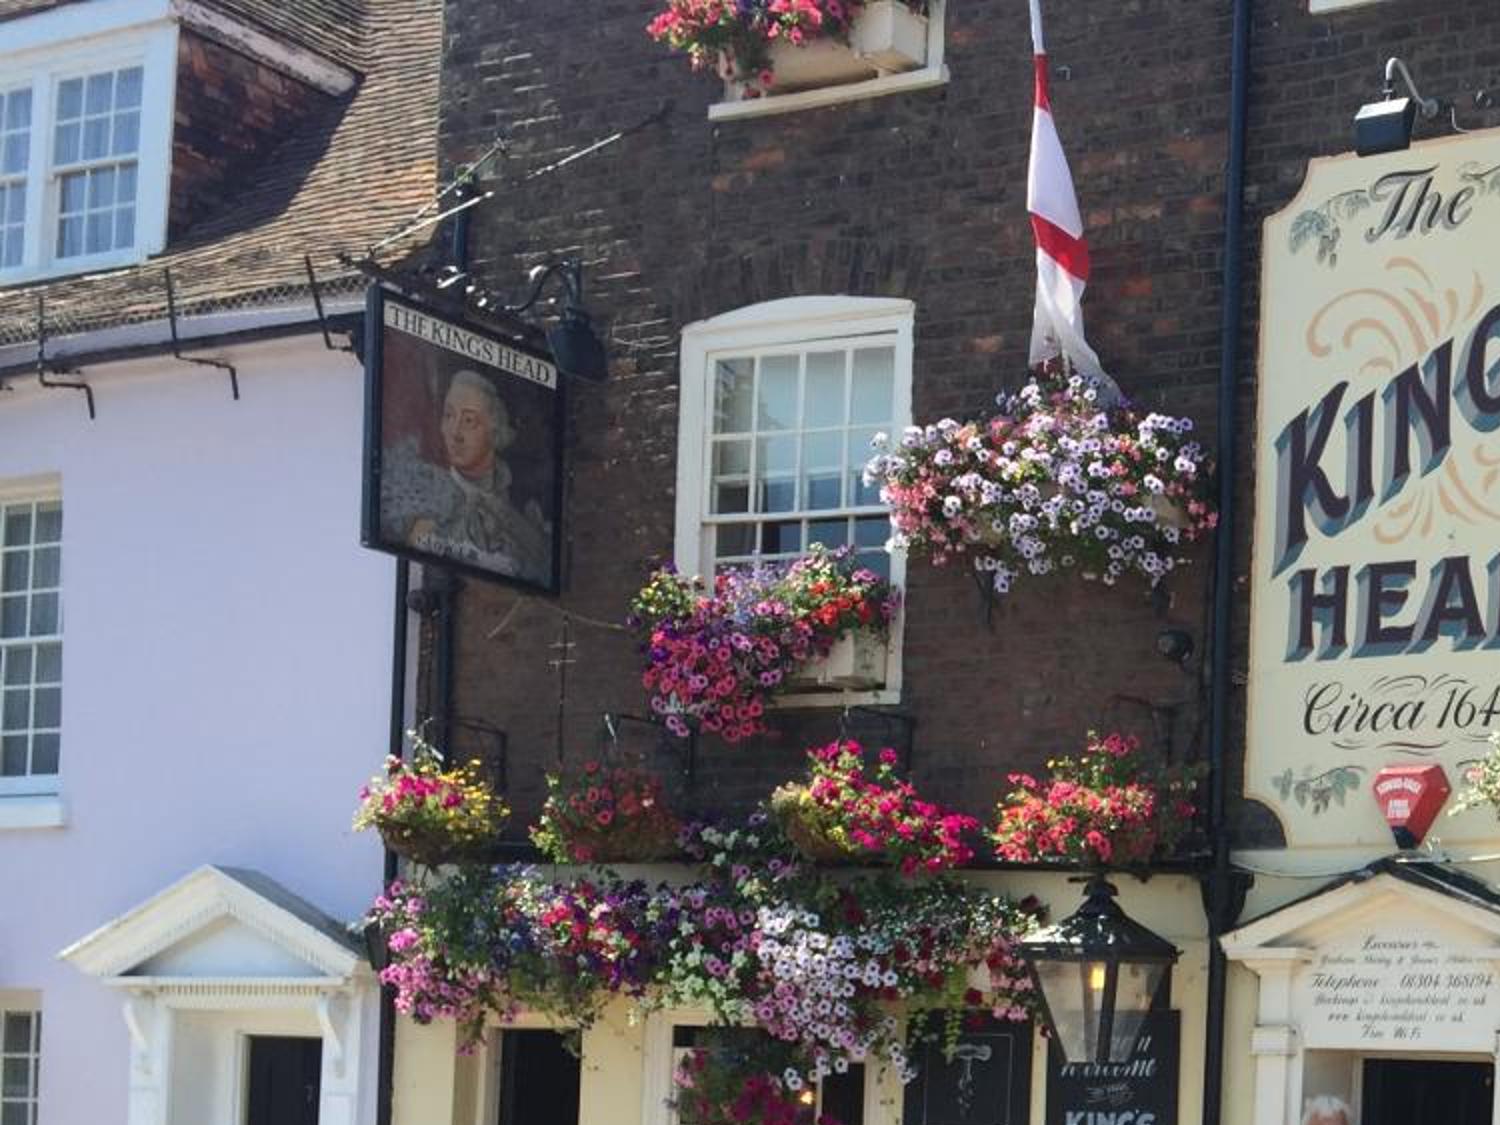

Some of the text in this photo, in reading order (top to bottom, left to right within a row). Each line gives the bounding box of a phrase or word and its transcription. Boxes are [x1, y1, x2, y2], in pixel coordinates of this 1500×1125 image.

[1364, 164, 1474, 243] The
[389, 304, 429, 339] THE
[497, 346, 551, 384] HEAD
[1303, 681, 1426, 736] Circa
